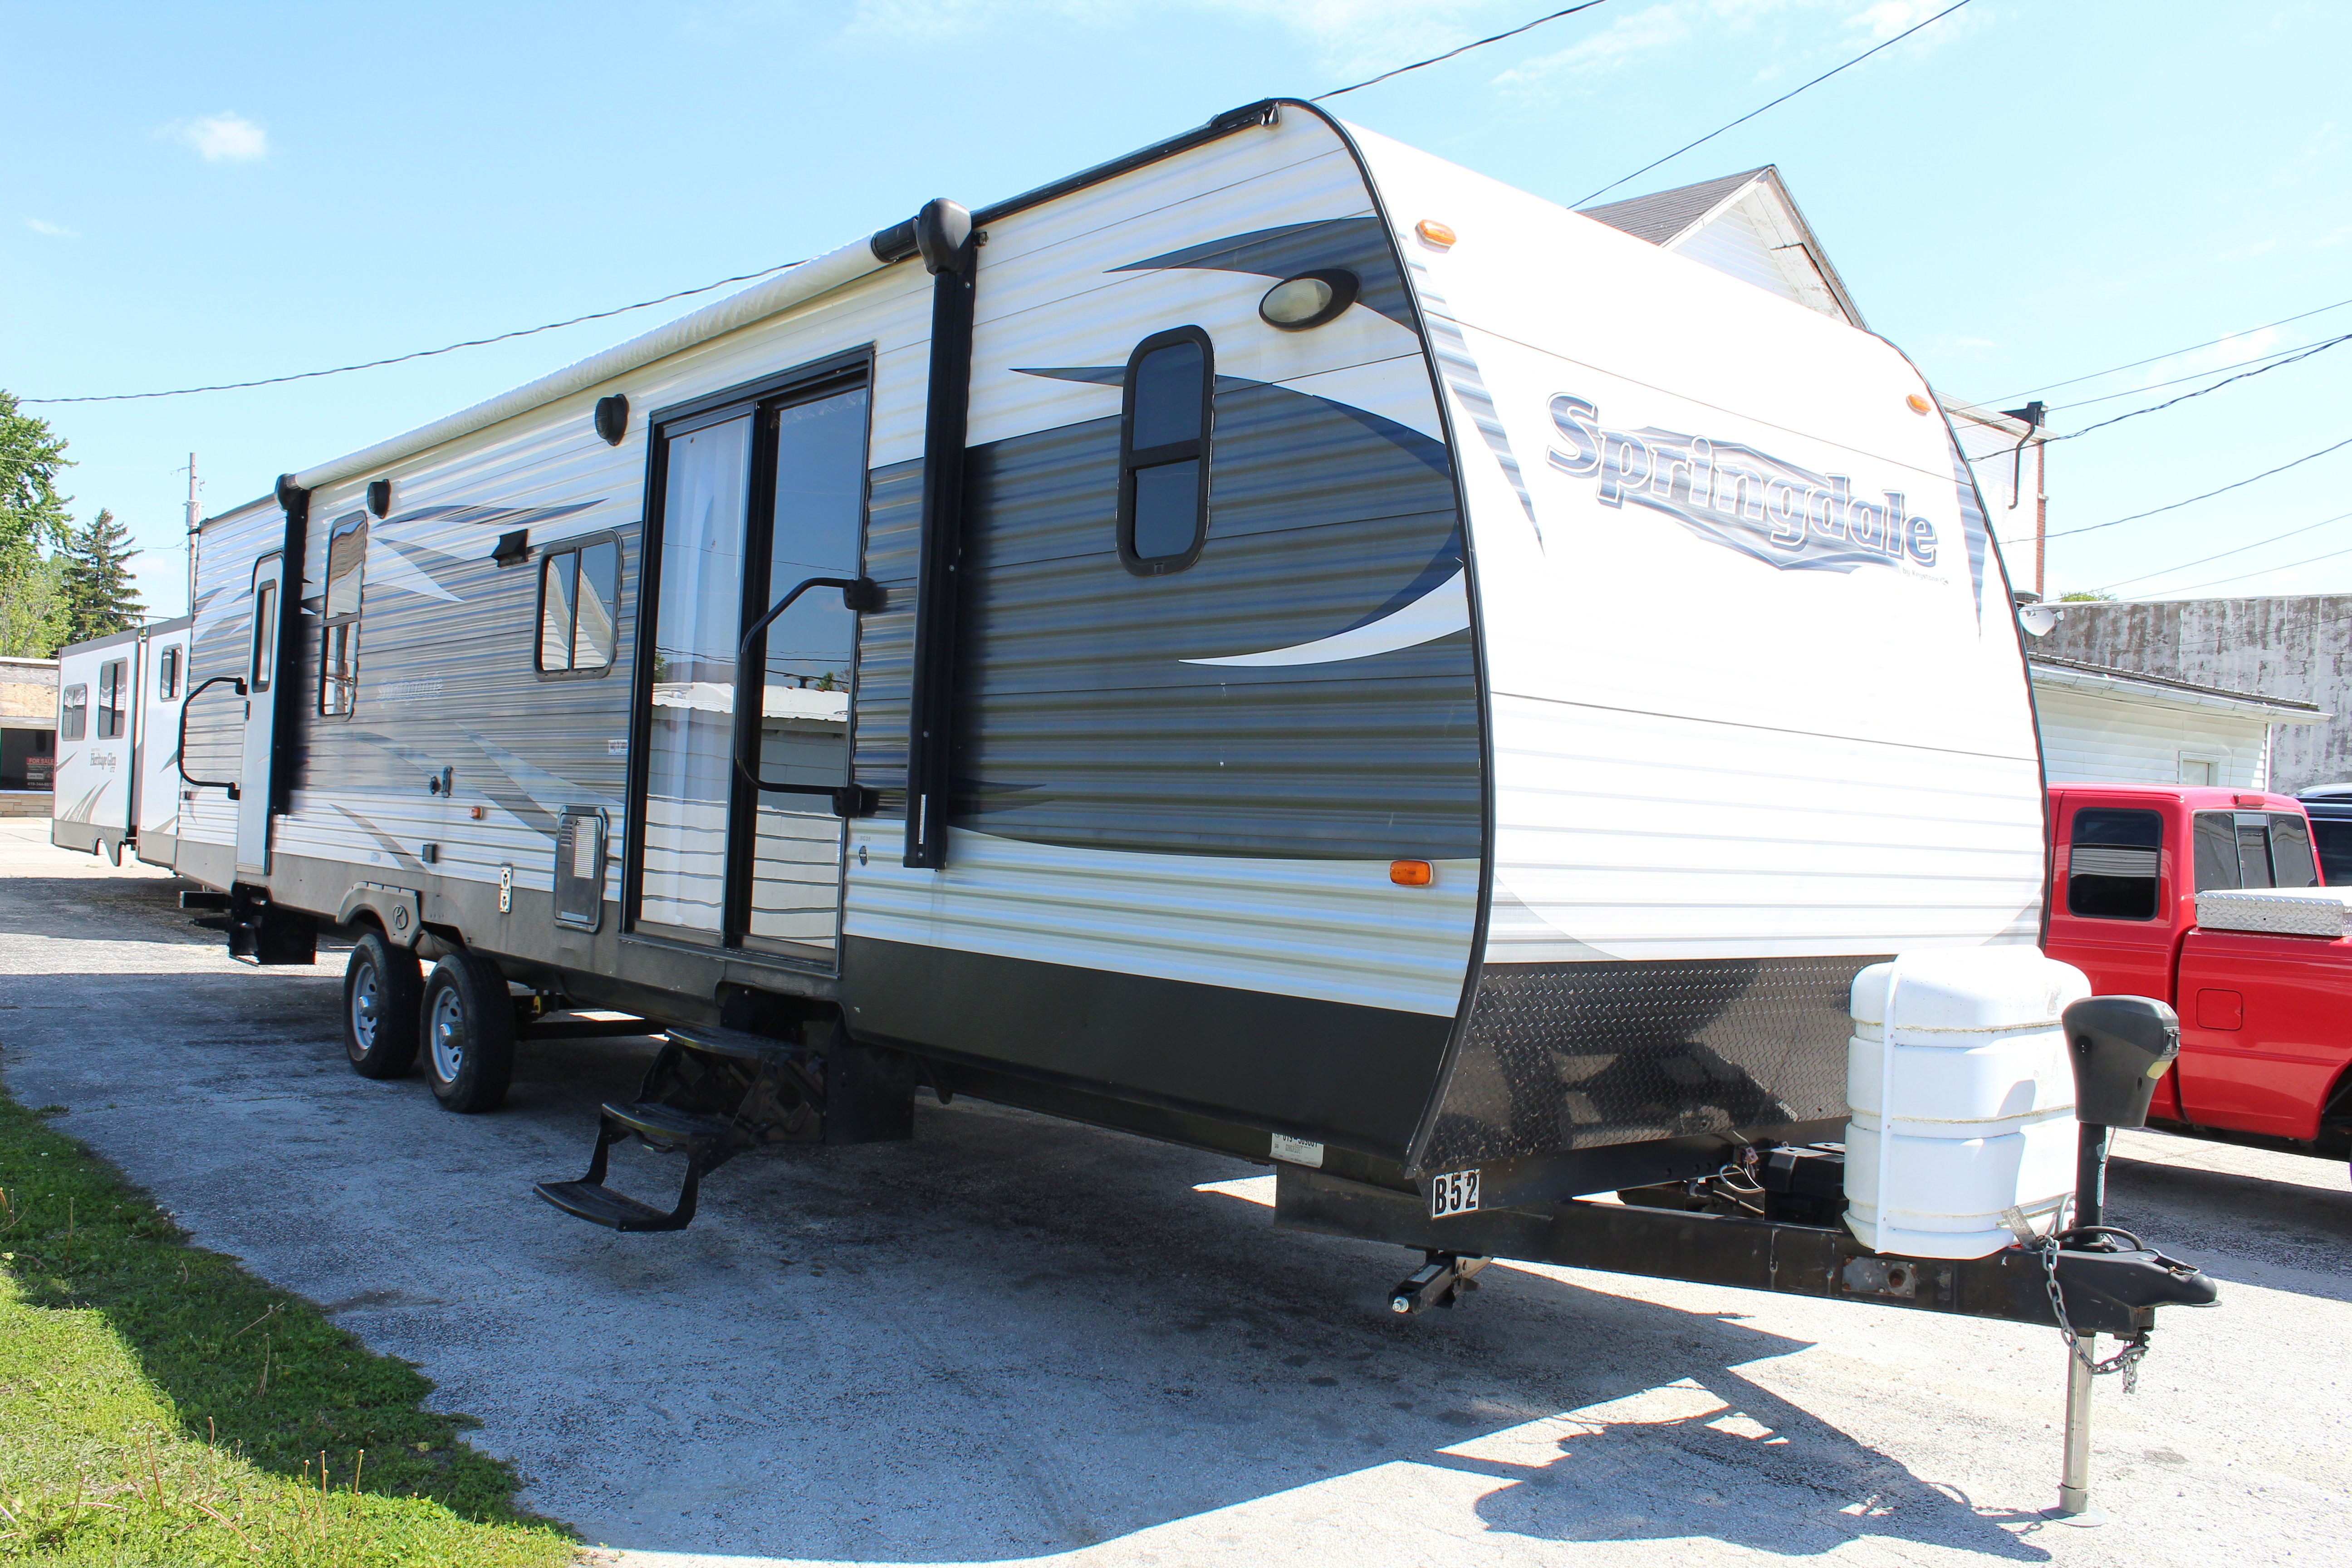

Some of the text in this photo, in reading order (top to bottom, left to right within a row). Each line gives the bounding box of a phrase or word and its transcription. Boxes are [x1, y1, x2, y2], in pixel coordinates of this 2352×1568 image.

[1545, 392, 1938, 567] Springdale
[1902, 567, 1939, 582] by Keystone
[90, 752, 116, 770] Heritage Glen
[1435, 1172, 1477, 1214] B52
